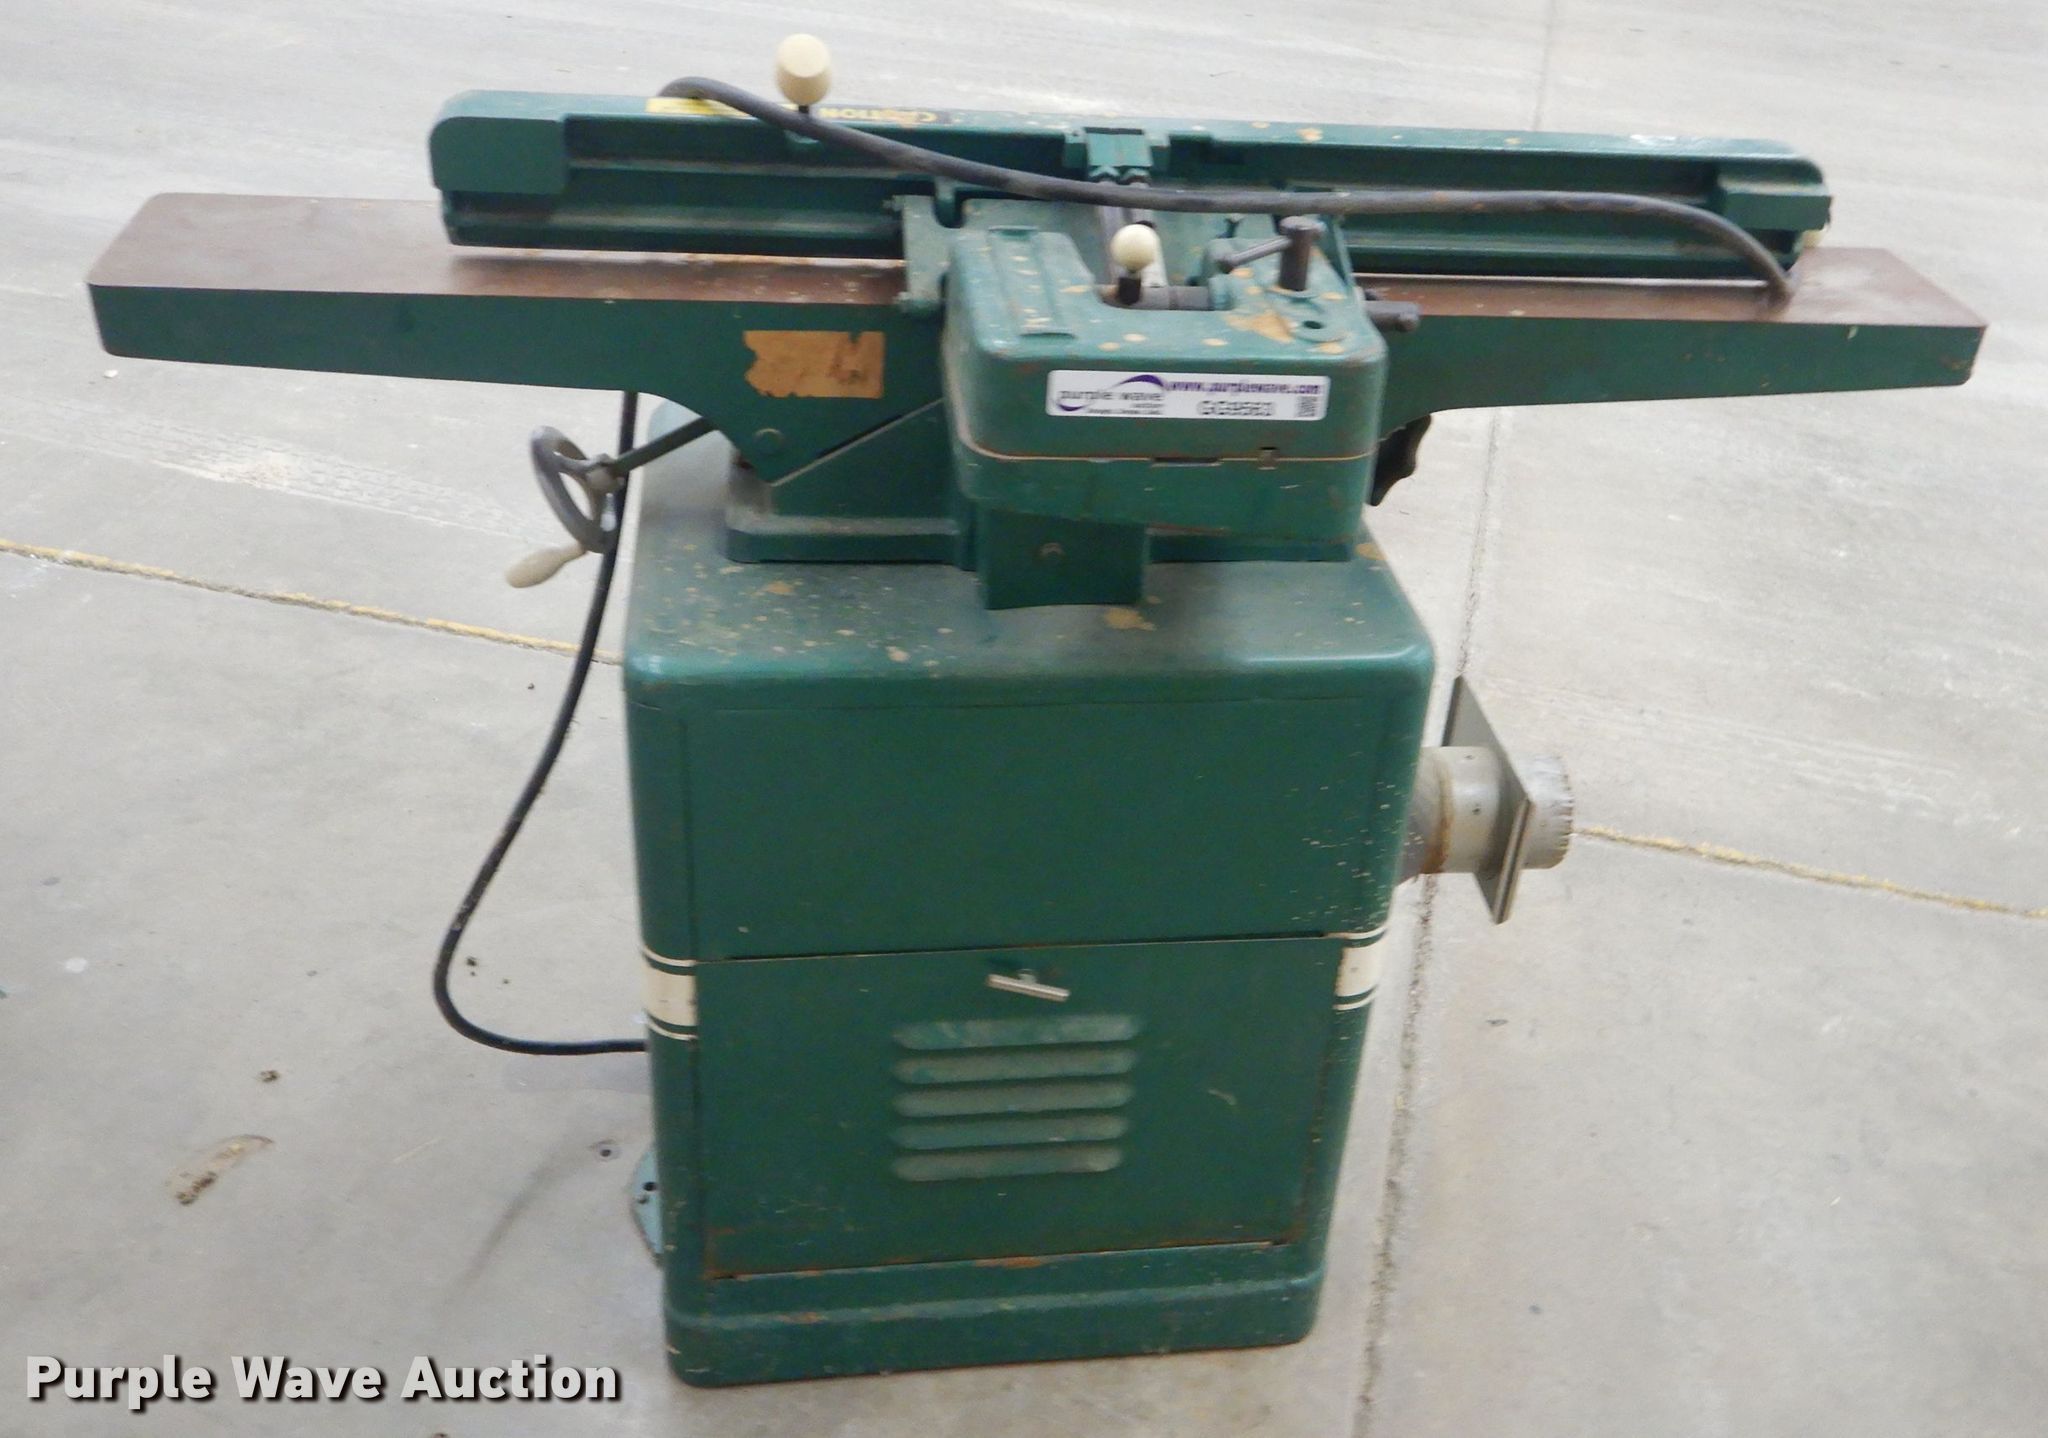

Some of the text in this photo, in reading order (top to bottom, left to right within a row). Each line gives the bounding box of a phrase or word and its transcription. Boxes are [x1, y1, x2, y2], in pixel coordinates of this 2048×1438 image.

[1165, 380, 1319, 395] www.purplewave.com
[1058, 390, 1163, 402] purple wave
